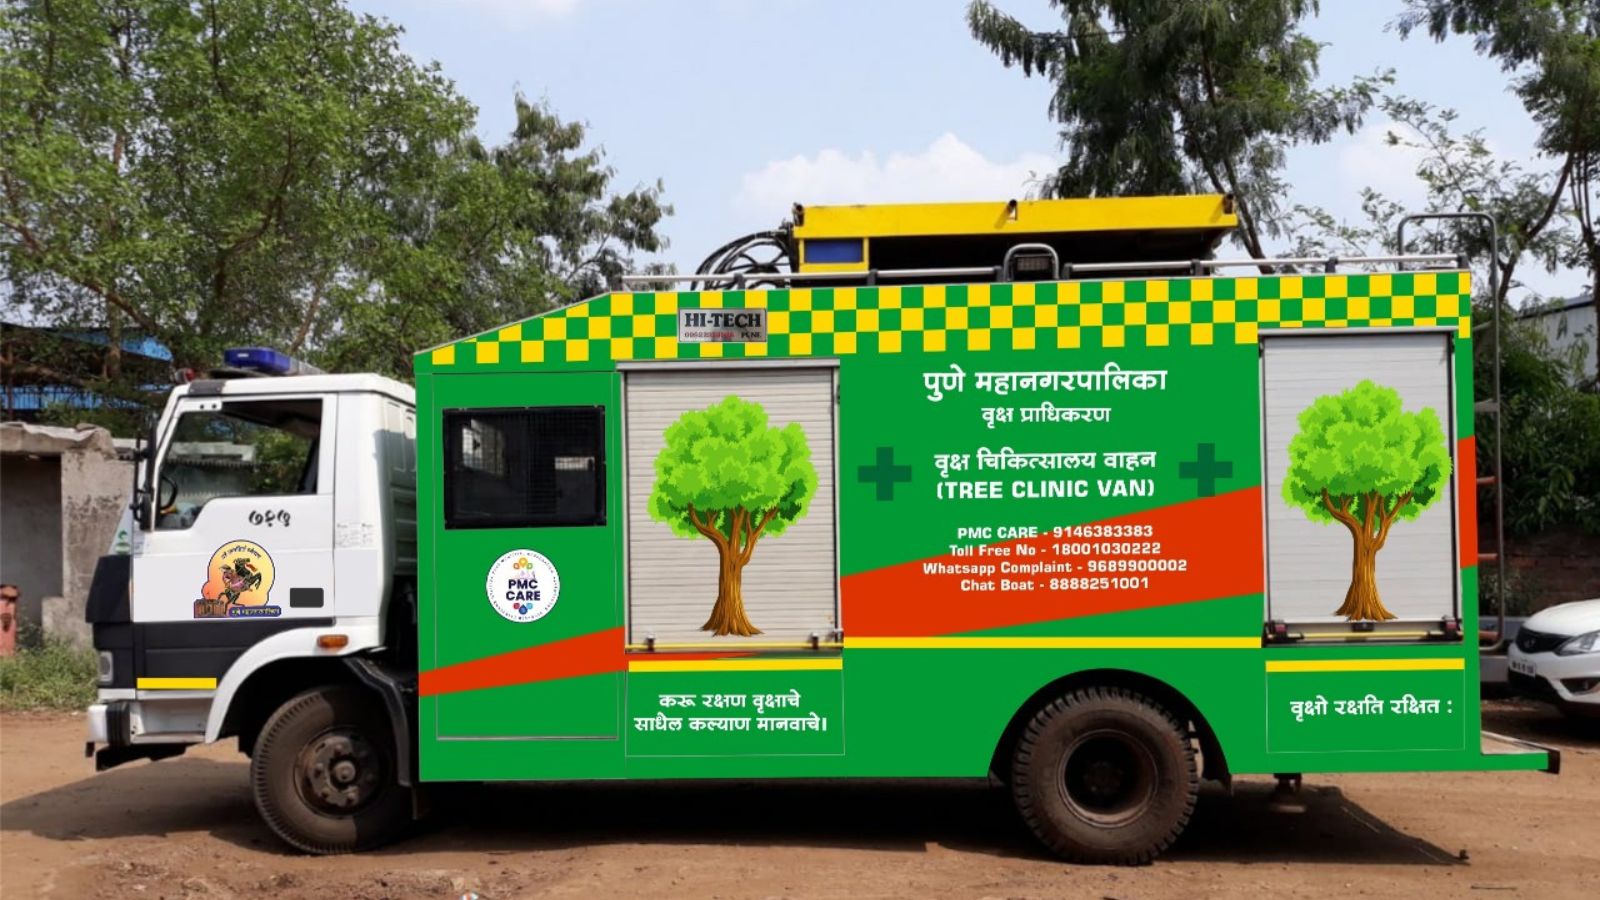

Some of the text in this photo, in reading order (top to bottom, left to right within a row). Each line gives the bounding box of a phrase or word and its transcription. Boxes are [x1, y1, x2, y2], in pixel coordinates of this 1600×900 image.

[684, 312, 762, 329] HI-TECH
[923, 361, 1168, 402] पुणे महानगरपालिका
[981, 401, 1112, 429] वृक्ष प्राधिकरण
[934, 446, 1157, 479] वृक्ष चिकित्सालय वाहन
[937, 479, 1155, 500] (TREE CLINIC VAN)
[957, 527, 992, 539] PMC
[997, 526, 1038, 539] CARE
[1053, 525, 1153, 538] 9146383383
[949, 544, 974, 557] Toll
[978, 544, 1011, 556] Free
[1016, 543, 1036, 556] No
[1052, 542, 1161, 555] 18001030222
[923, 562, 996, 576] Whatsapp
[1000, 560, 1072, 576] Complaint
[1087, 559, 1187, 572] 9689900002
[508, 578, 538, 590] PMC
[960, 579, 995, 592] Chat
[1000, 579, 1034, 591] Boat
[1049, 576, 1149, 590] 8888251001
[505, 590, 541, 601] CARE
[657, 688, 801, 714] करू रक्षण वृक्षाचे
[1289, 694, 1329, 722] वृक्षो
[1333, 693, 1385, 715] रक्षति
[1389, 693, 1441, 715] रक्षित
[633, 711, 683, 731] साधेल
[688, 717, 752, 731] कल्याण
